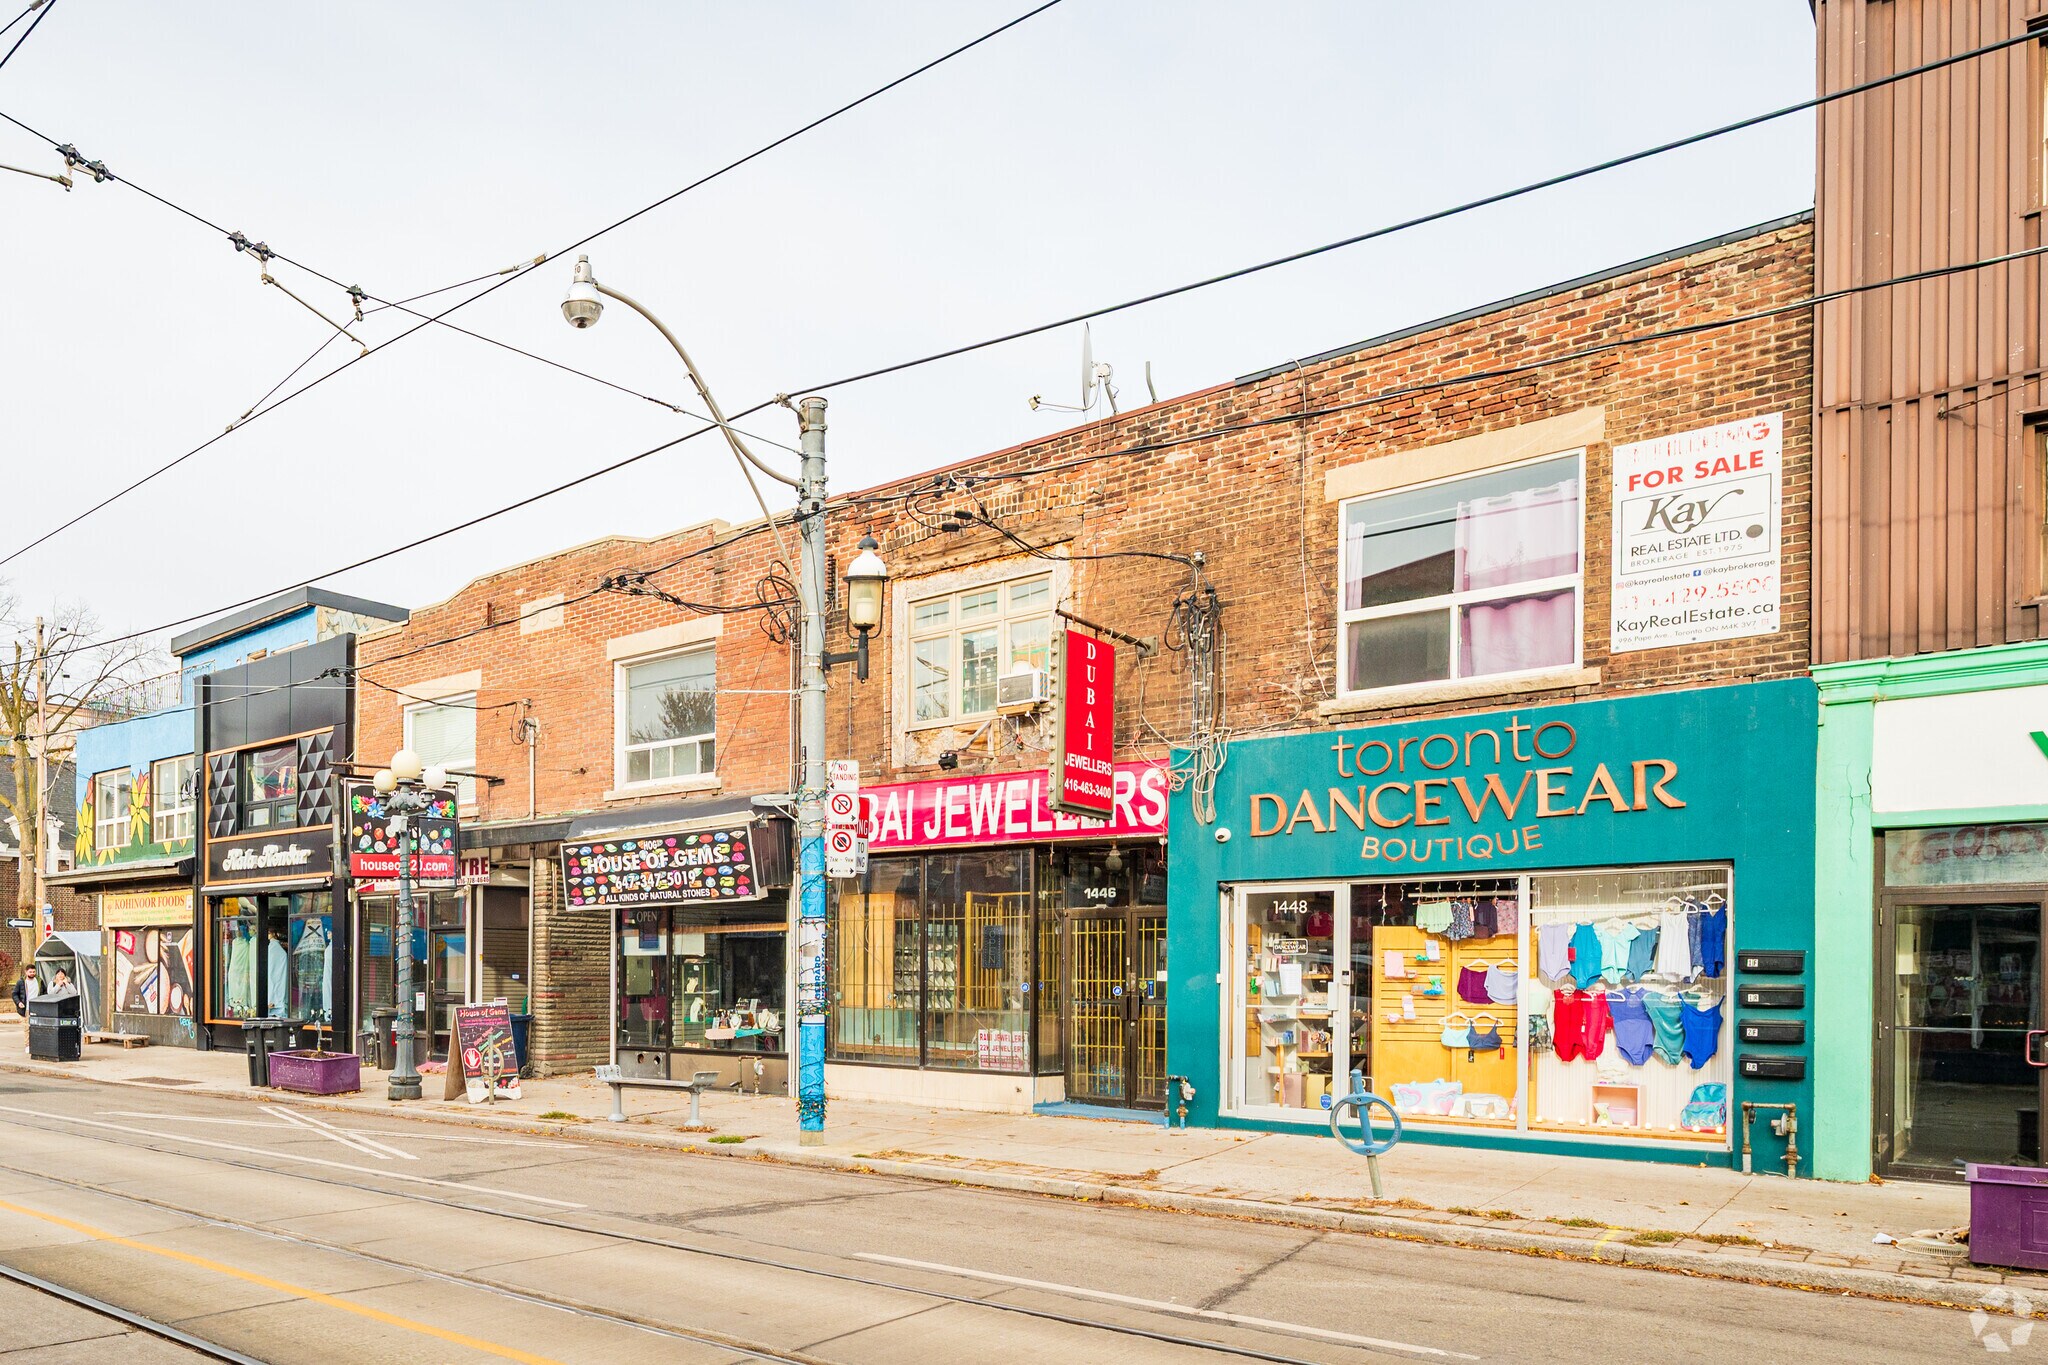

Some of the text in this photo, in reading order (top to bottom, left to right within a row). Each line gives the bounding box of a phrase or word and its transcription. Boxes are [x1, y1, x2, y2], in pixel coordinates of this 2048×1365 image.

[1628, 450, 1764, 492] FOR SALE
[1641, 489, 1744, 534] Kay
[1631, 530, 1743, 557] REAL ESTATE LTD.
[1630, 552, 1689, 568] BROKERAGE
[1625, 559, 1776, 588] @kayrealestate @kaybrokerage
[1617, 603, 1774, 633] KayRealEstate.ca
[1675, 629, 1703, 637] Toronto
[1705, 625, 1719, 633] ON
[1085, 641, 1097, 751] DUBAI
[1331, 715, 1577, 778] toronto
[838, 763, 848, 772] NO
[1064, 752, 1113, 777] JEWELLERS
[829, 773, 858, 781] STANDING
[1063, 777, 1112, 799] 416-463-3400
[860, 767, 1167, 842] BAI JEWELRS
[1249, 759, 1687, 838] DANCEWEAR
[1361, 824, 1544, 863] BOUTIQUE
[460, 856, 489, 876] TRE
[586, 846, 724, 875] HOUSE OF GEMS
[615, 870, 696, 890] 647-347-5019
[114, 895, 185, 910] KOHINOOR FOODS
[606, 887, 711, 903] ALL KINDS OF NATURAL STONES
[1084, 887, 1117, 899] 1446
[636, 910, 658, 923] OPEN
[1273, 900, 1308, 914] 1448
[459, 1008, 507, 1019] House of Gems
